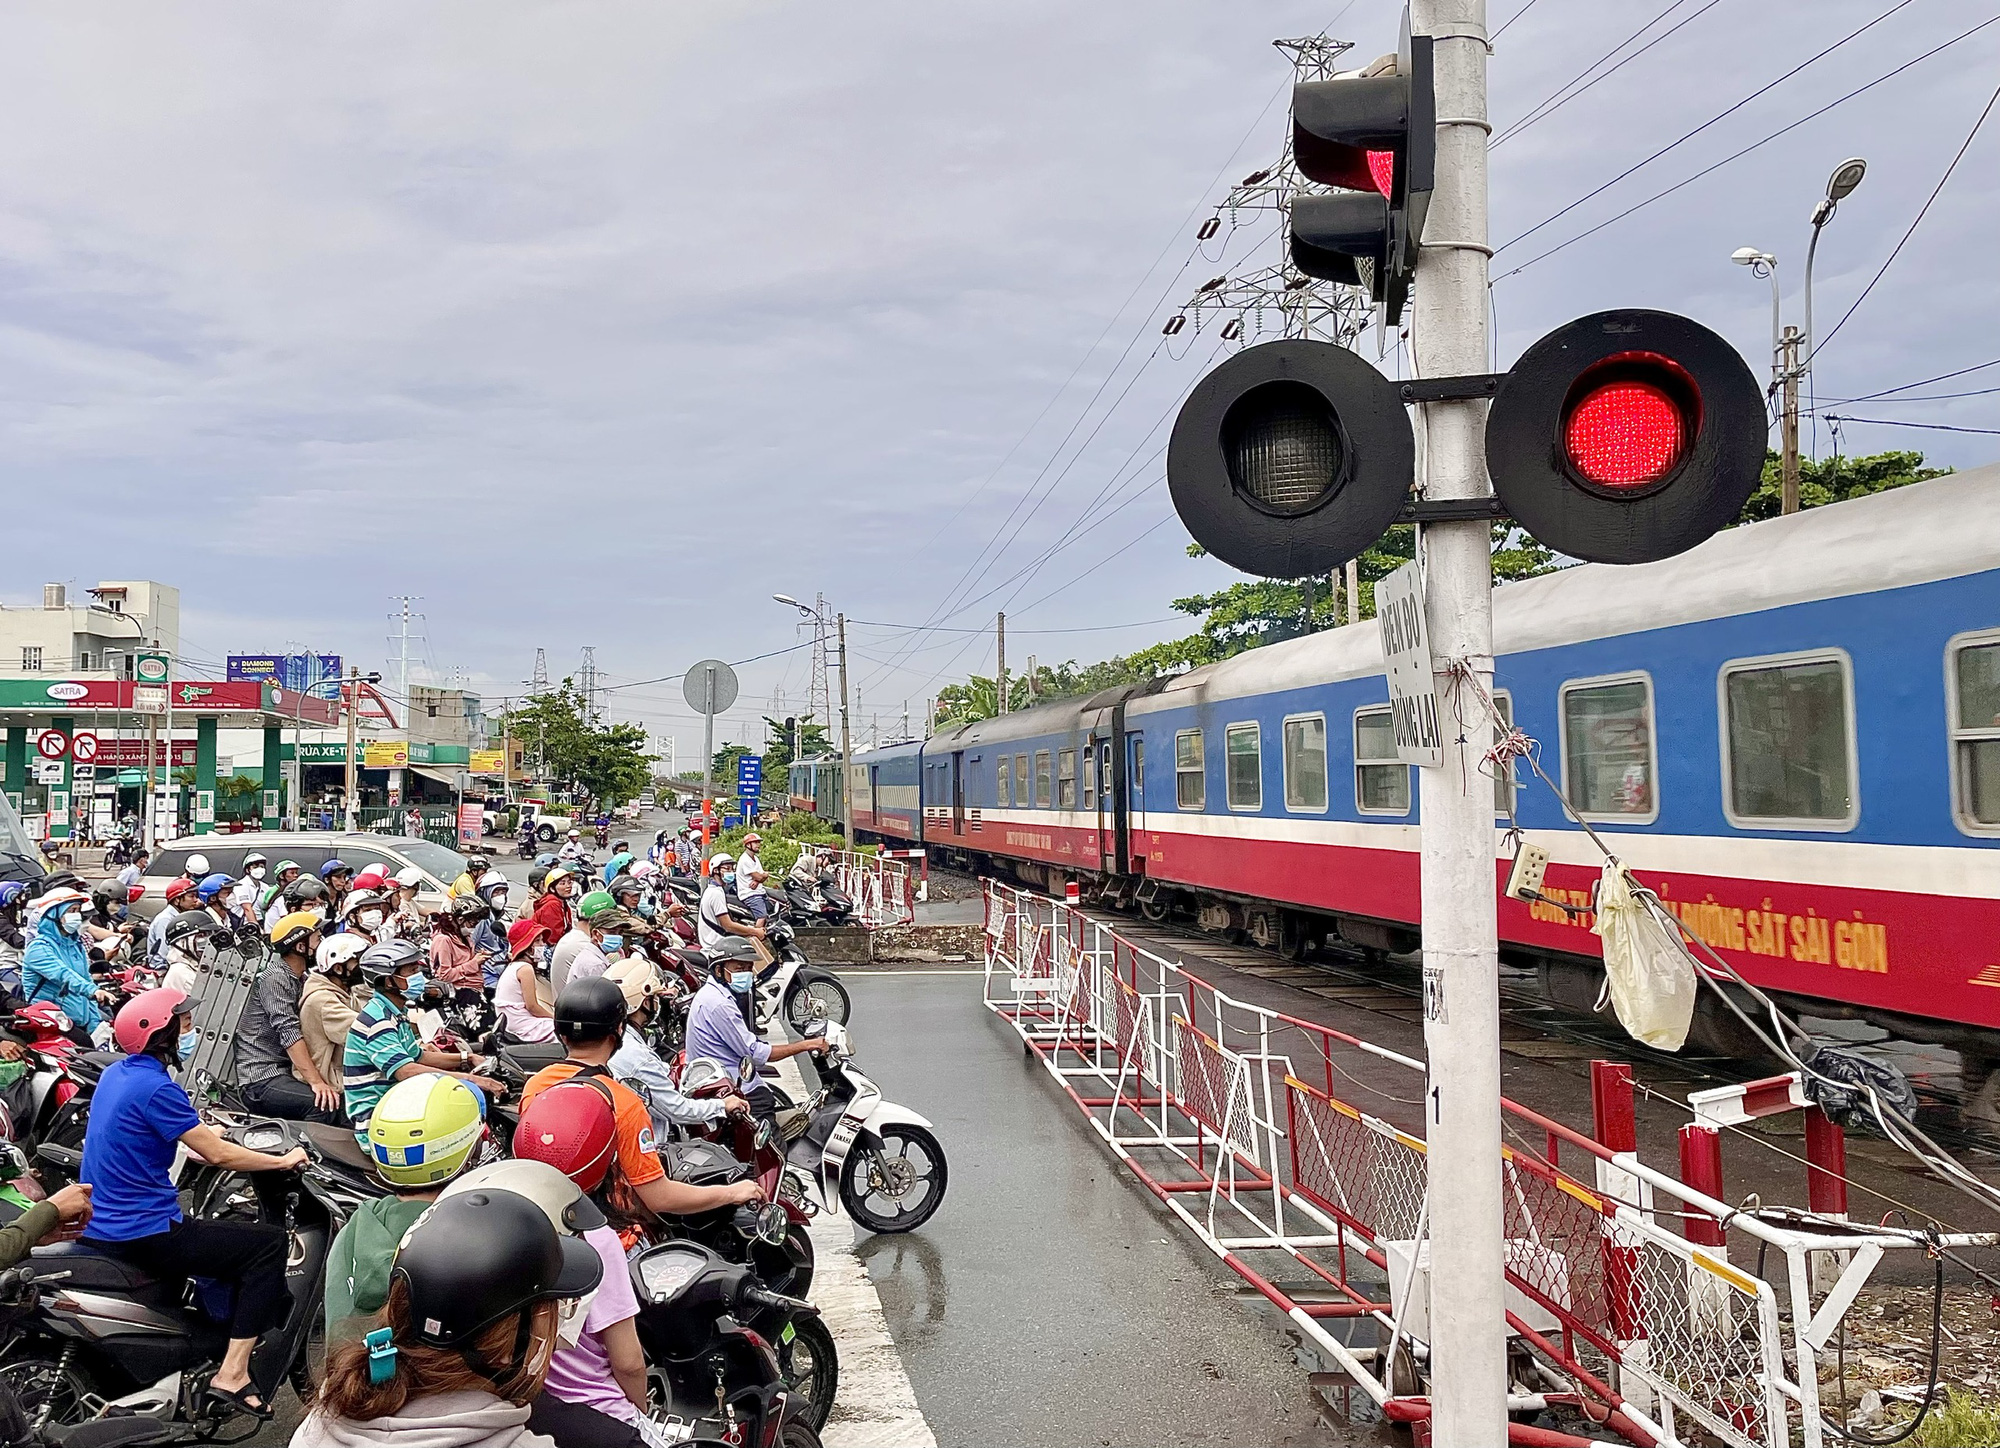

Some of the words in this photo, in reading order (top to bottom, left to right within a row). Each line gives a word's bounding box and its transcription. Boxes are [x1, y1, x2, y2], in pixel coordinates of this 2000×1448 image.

[143, 663, 162, 672] SATRA
[53, 687, 82, 696] SATRA
[1746, 897, 1788, 958] SẮT
[1789, 907, 1832, 965] SÀI
[1834, 910, 1889, 974] GÒN
[389, 1151, 403, 1159] SG
[284, 1269, 305, 1278] NDA
